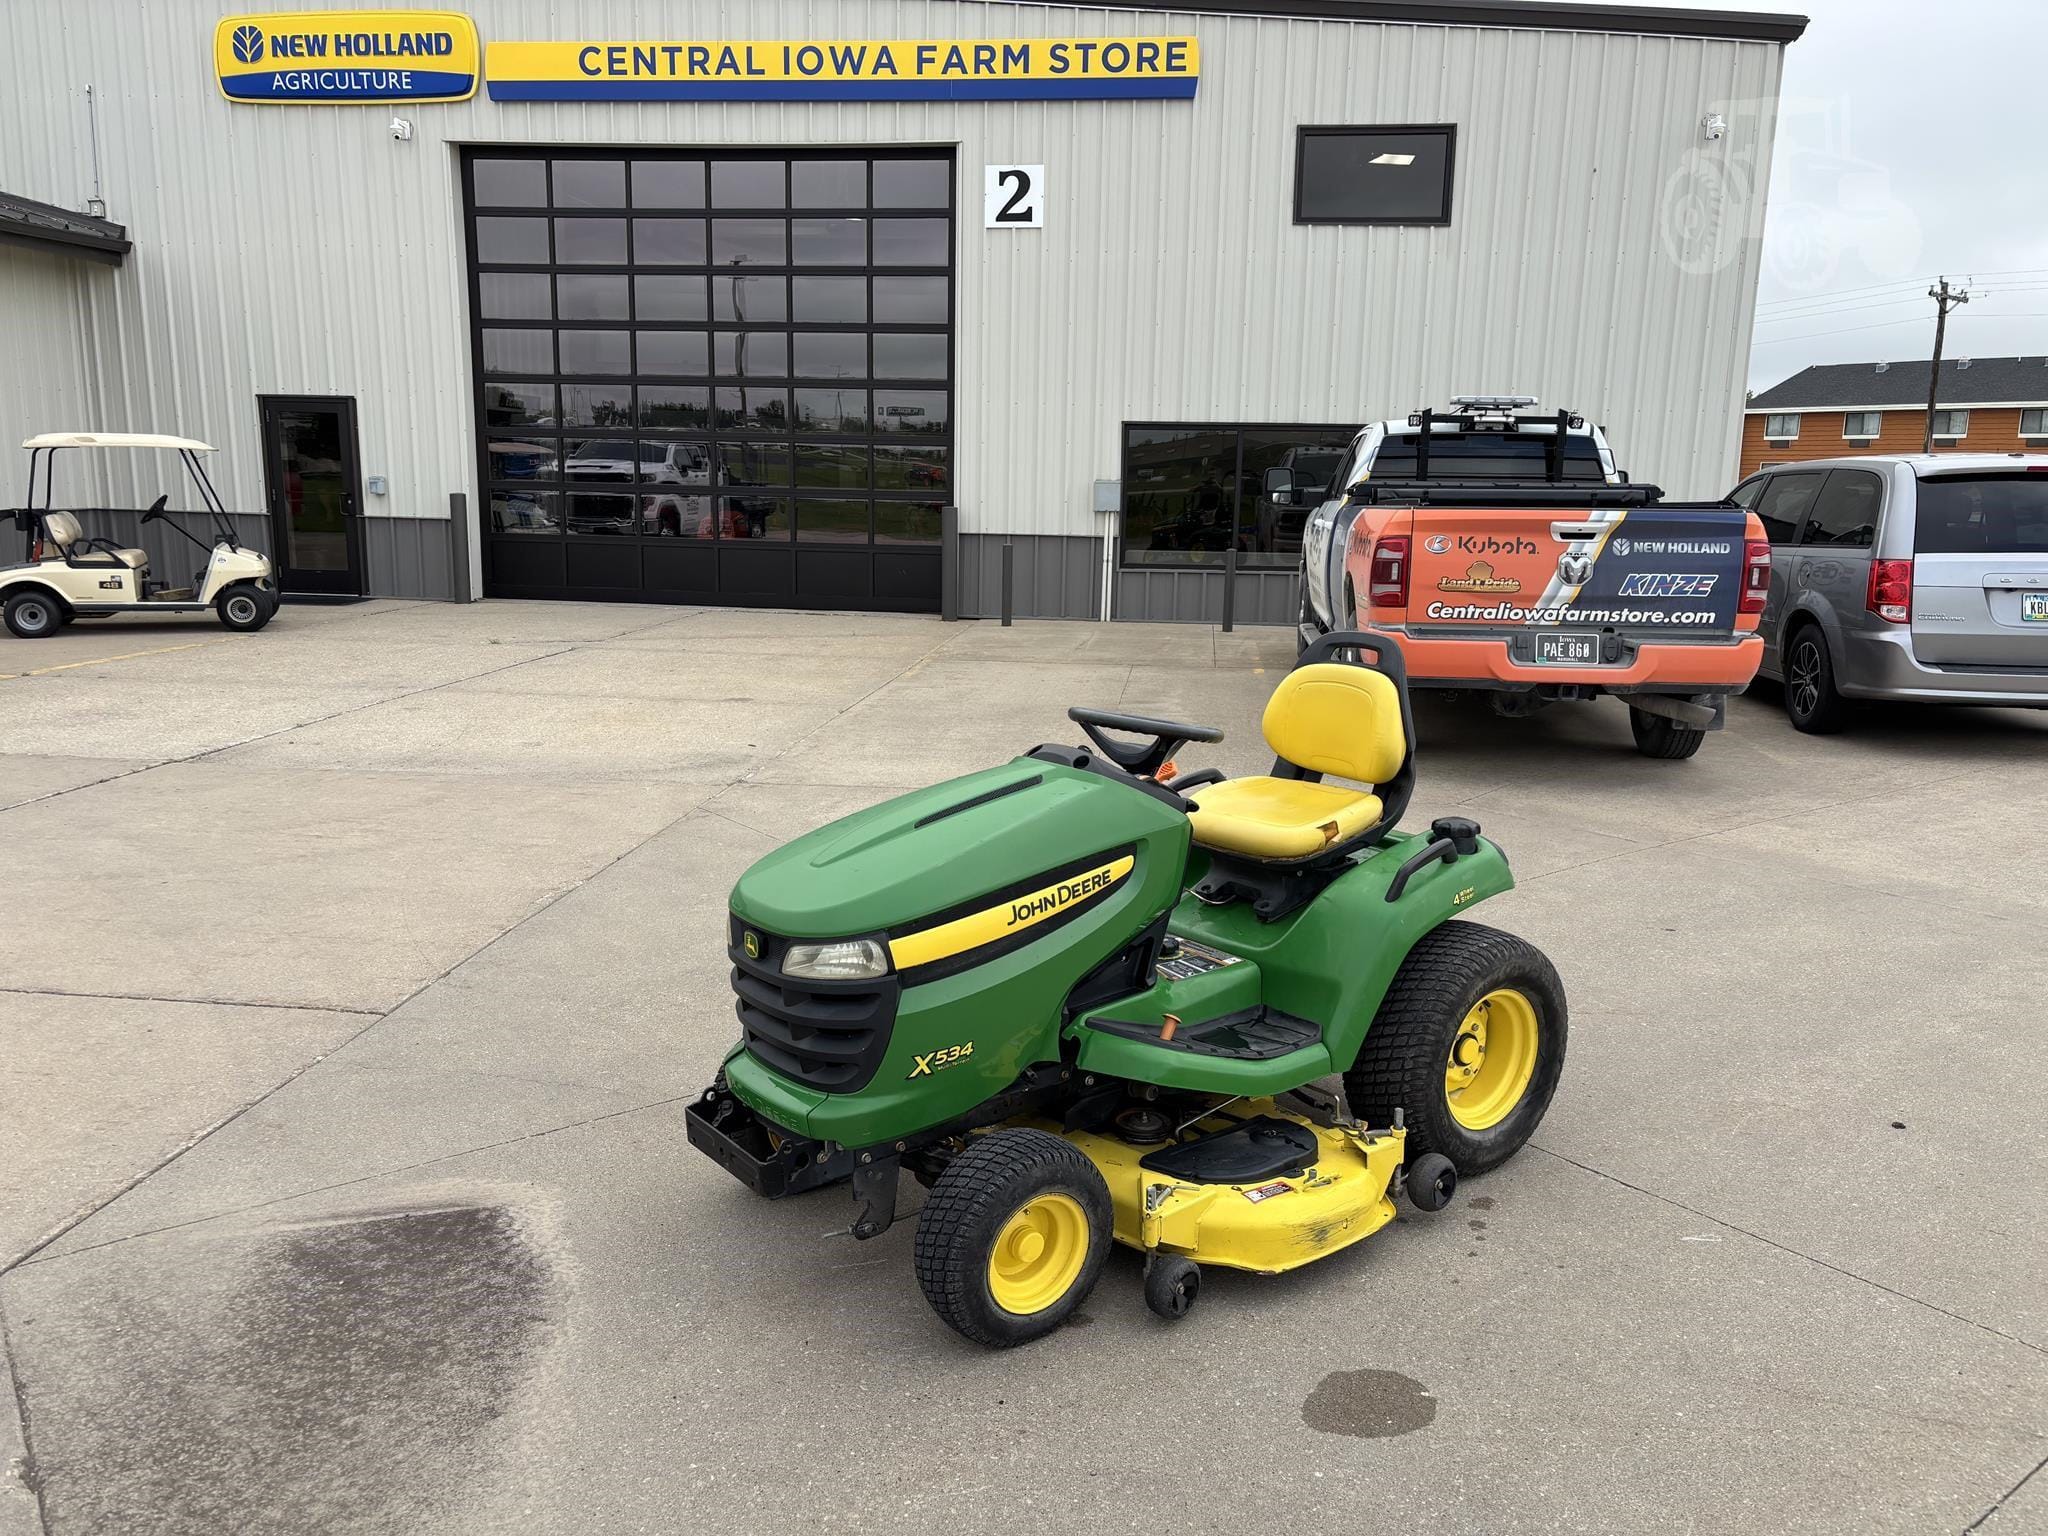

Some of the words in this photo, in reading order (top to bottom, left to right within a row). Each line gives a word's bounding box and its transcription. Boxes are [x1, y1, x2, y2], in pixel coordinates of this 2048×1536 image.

[271, 34, 328, 58] NEW
[334, 33, 453, 57] HOLLAND
[579, 46, 766, 76] CENTRAL
[783, 45, 898, 75] IOWA
[916, 44, 1030, 75] FARM
[1049, 42, 1188, 74] STORE
[272, 72, 412, 90] AGRICULTURE
[995, 169, 1034, 223] 2
[1458, 536, 1537, 554] Kubota
[1633, 542, 1665, 553] NEW
[1667, 542, 1731, 554] HOLLAND
[1440, 576, 1473, 586] Land
[1485, 576, 1520, 586] Pride
[1618, 573, 1719, 597] KINZE
[1425, 602, 1716, 624] Centraliowafarmstore.com
[1543, 642, 1565, 657] PAE
[1568, 642, 1590, 658] 860
[1007, 893, 1056, 926] JOHN
[1057, 869, 1111, 905] DEERE
[1453, 893, 1460, 905] 4
[906, 1040, 974, 1079] X534
